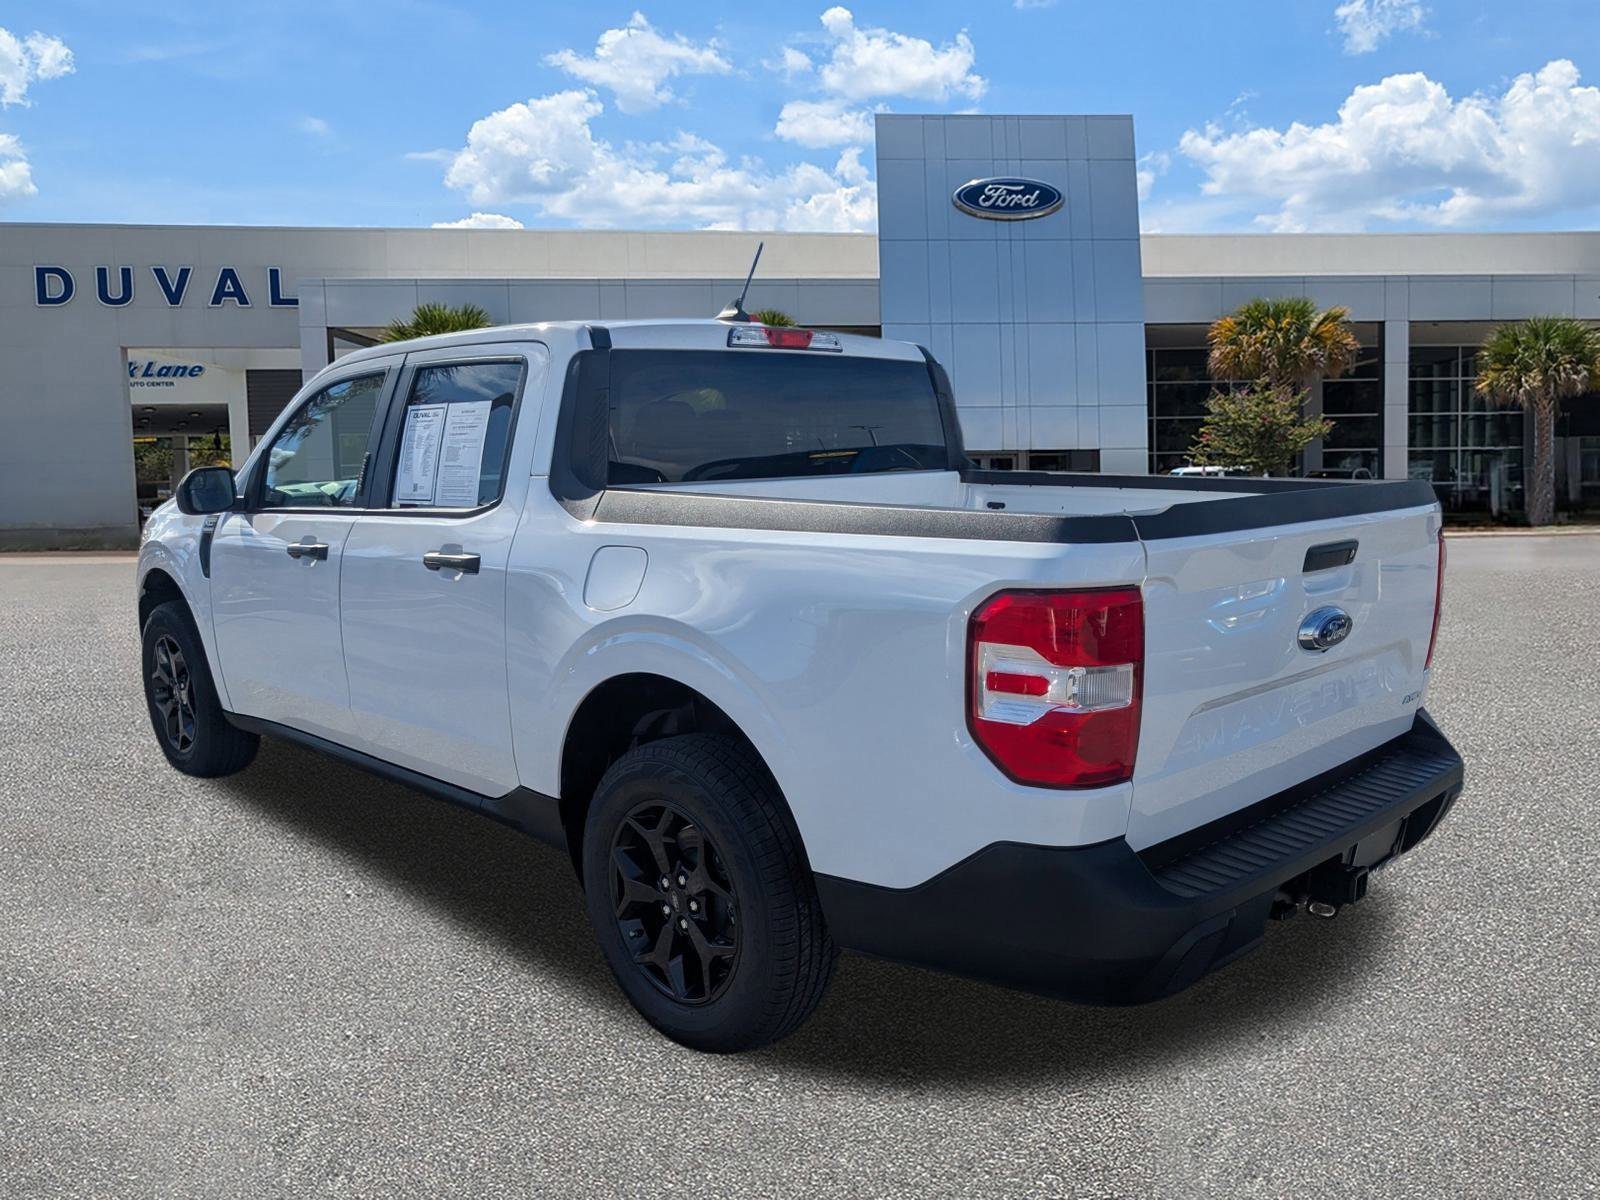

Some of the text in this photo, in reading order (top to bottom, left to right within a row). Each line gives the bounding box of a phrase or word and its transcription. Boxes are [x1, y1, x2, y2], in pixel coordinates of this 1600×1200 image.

[978, 184, 1041, 208] Ford
[34, 265, 299, 308] DUVAL
[142, 361, 206, 378] Lane
